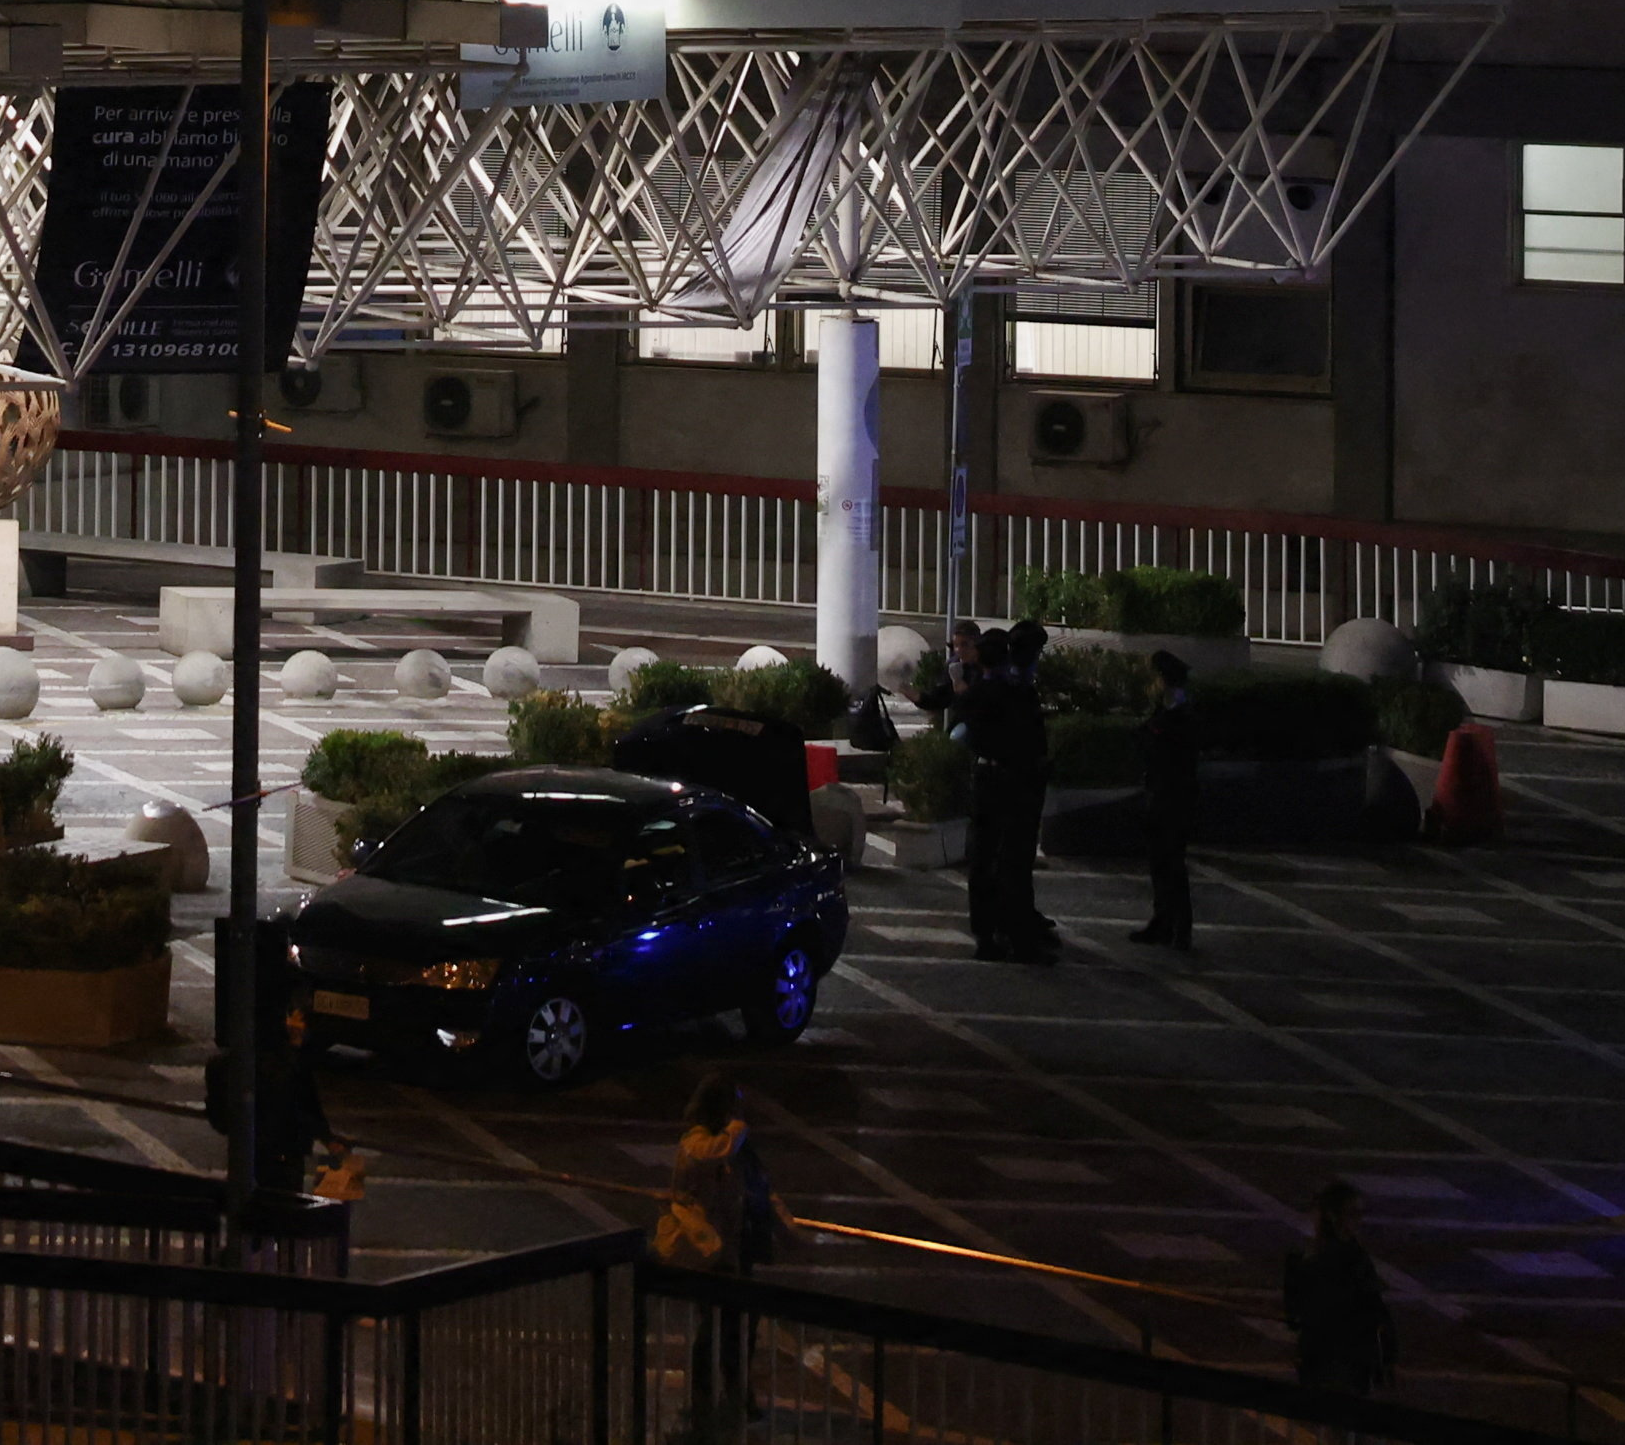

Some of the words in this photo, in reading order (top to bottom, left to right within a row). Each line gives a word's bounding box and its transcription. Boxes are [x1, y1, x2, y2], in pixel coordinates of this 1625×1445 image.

[94, 105, 124, 121] Per
[128, 106, 198, 123] arrive
[92, 129, 135, 145] cura
[139, 128, 218, 146] abiamo
[103, 150, 118, 167] di
